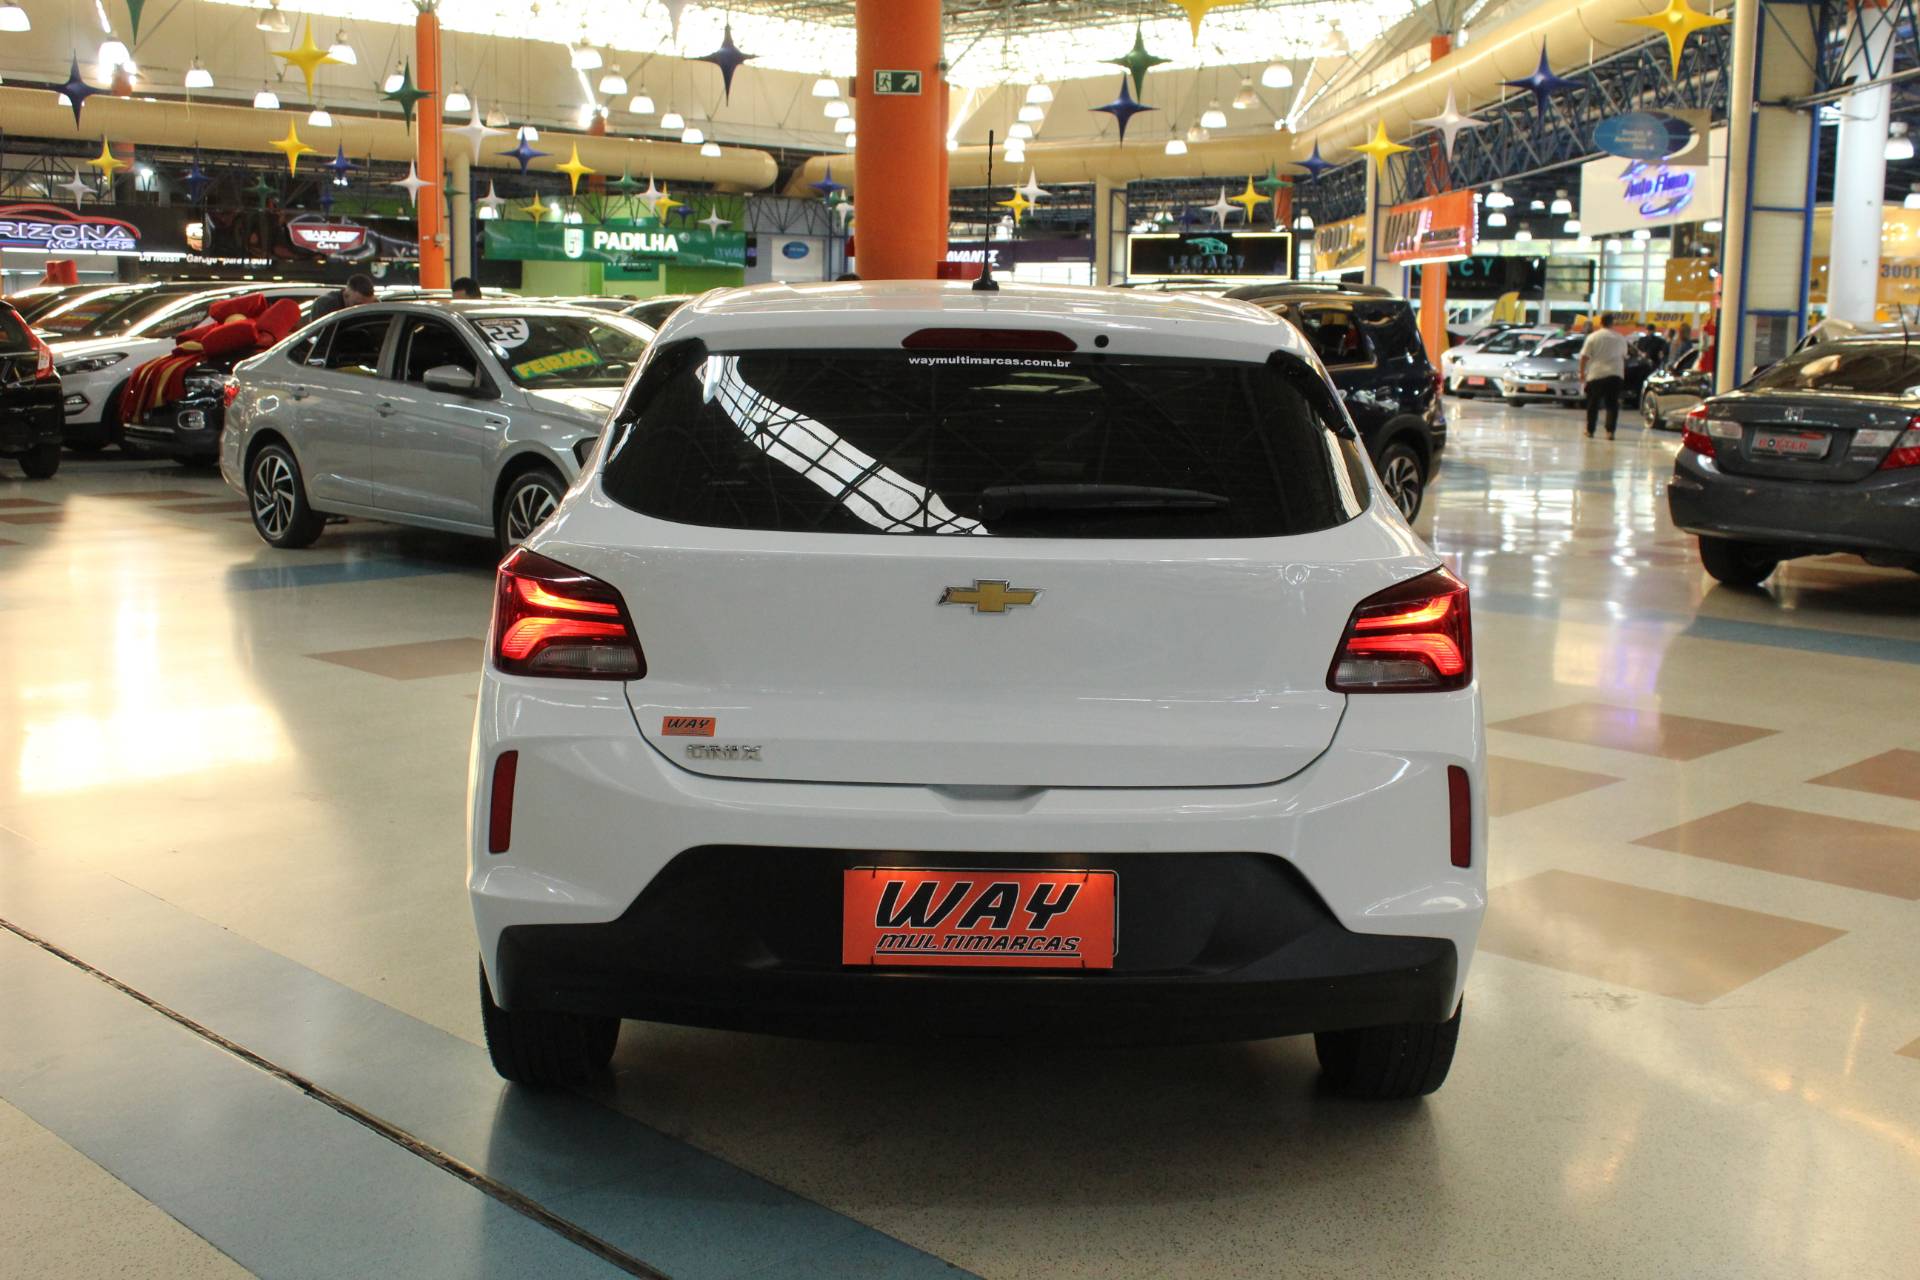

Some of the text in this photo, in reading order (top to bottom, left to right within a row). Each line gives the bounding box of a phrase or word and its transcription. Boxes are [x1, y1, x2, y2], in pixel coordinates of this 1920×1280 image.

[593, 230, 679, 252] PADILHA
[908, 355, 1072, 368] waymultimarcas.com.br
[667, 718, 711, 729] WAY
[874, 880, 1083, 931] WAY
[875, 933, 1082, 952] MULTIMARCAS
